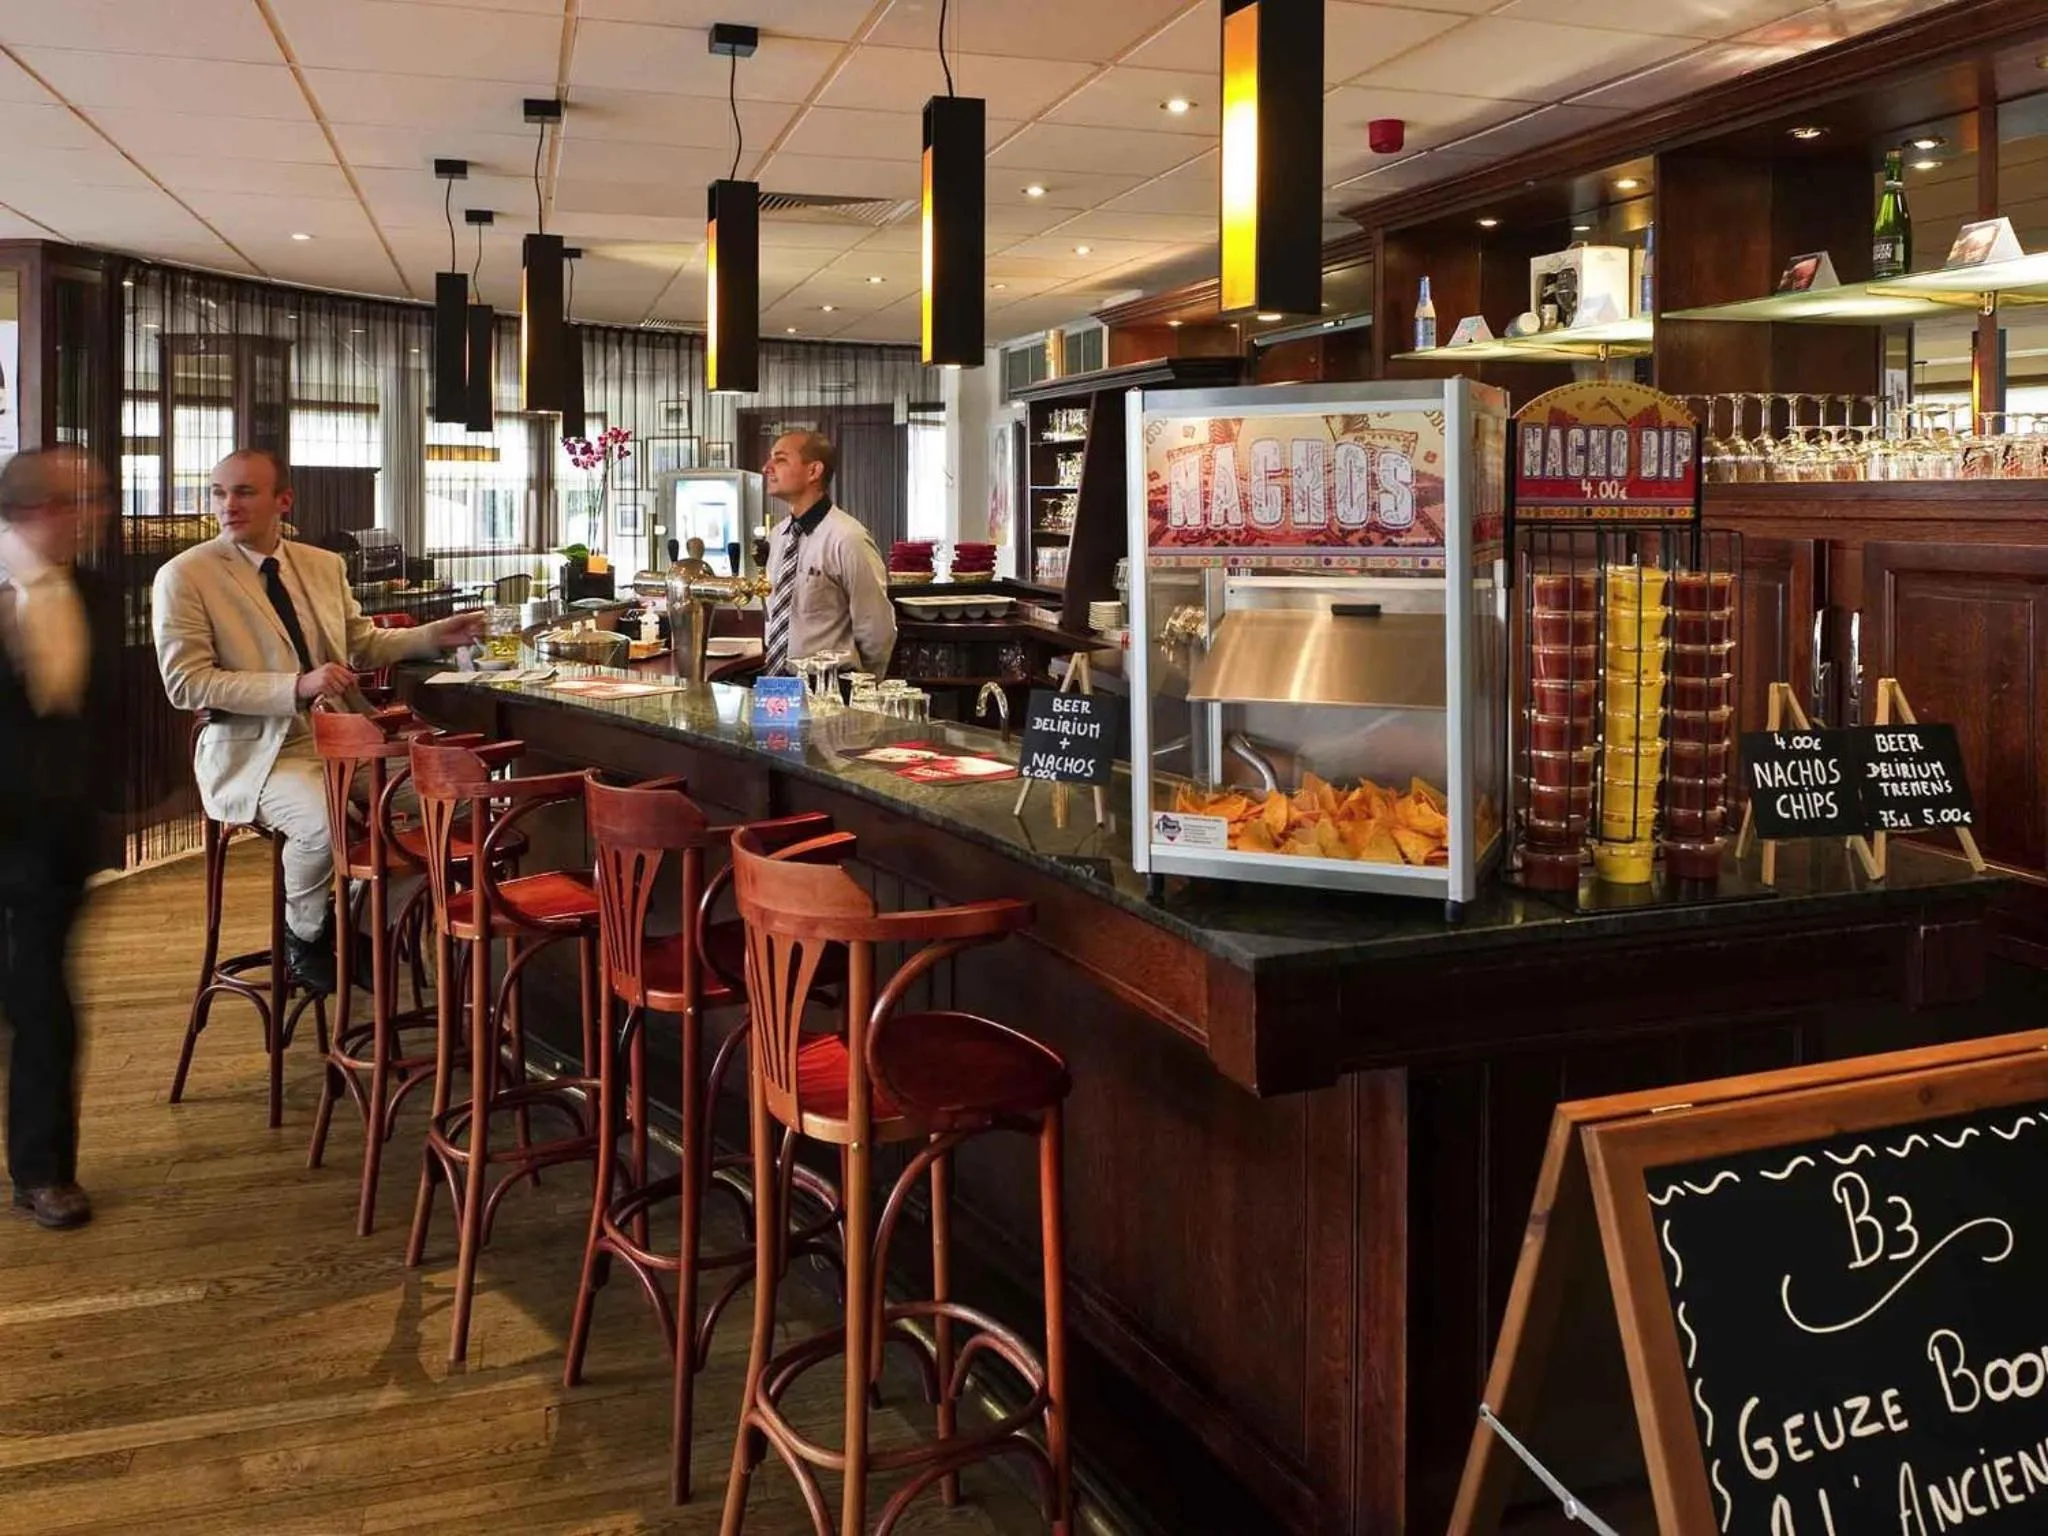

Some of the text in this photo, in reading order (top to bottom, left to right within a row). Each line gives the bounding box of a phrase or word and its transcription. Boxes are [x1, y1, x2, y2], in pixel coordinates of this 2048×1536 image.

[1522, 426, 1693, 479] NACHO DIP
[1168, 438, 1416, 529] NACHOS
[1581, 478, 1628, 500] 4.00€
[1052, 697, 1092, 714] BEER
[1031, 714, 1100, 739] DELIRIUM
[1773, 732, 1821, 750] 4.00€
[1875, 733, 1924, 753] BEER
[1031, 752, 1096, 777] NACHOS
[1753, 758, 1841, 789] NACHOS
[1866, 757, 1946, 780] DELIRIUM
[1878, 780, 1953, 797] TREMENS
[1776, 787, 1839, 820] CHIPS
[1922, 808, 1972, 825] 5.00€
[1832, 1171, 1920, 1270] B3
[1738, 1328, 2048, 1481] GEUZE BOO
